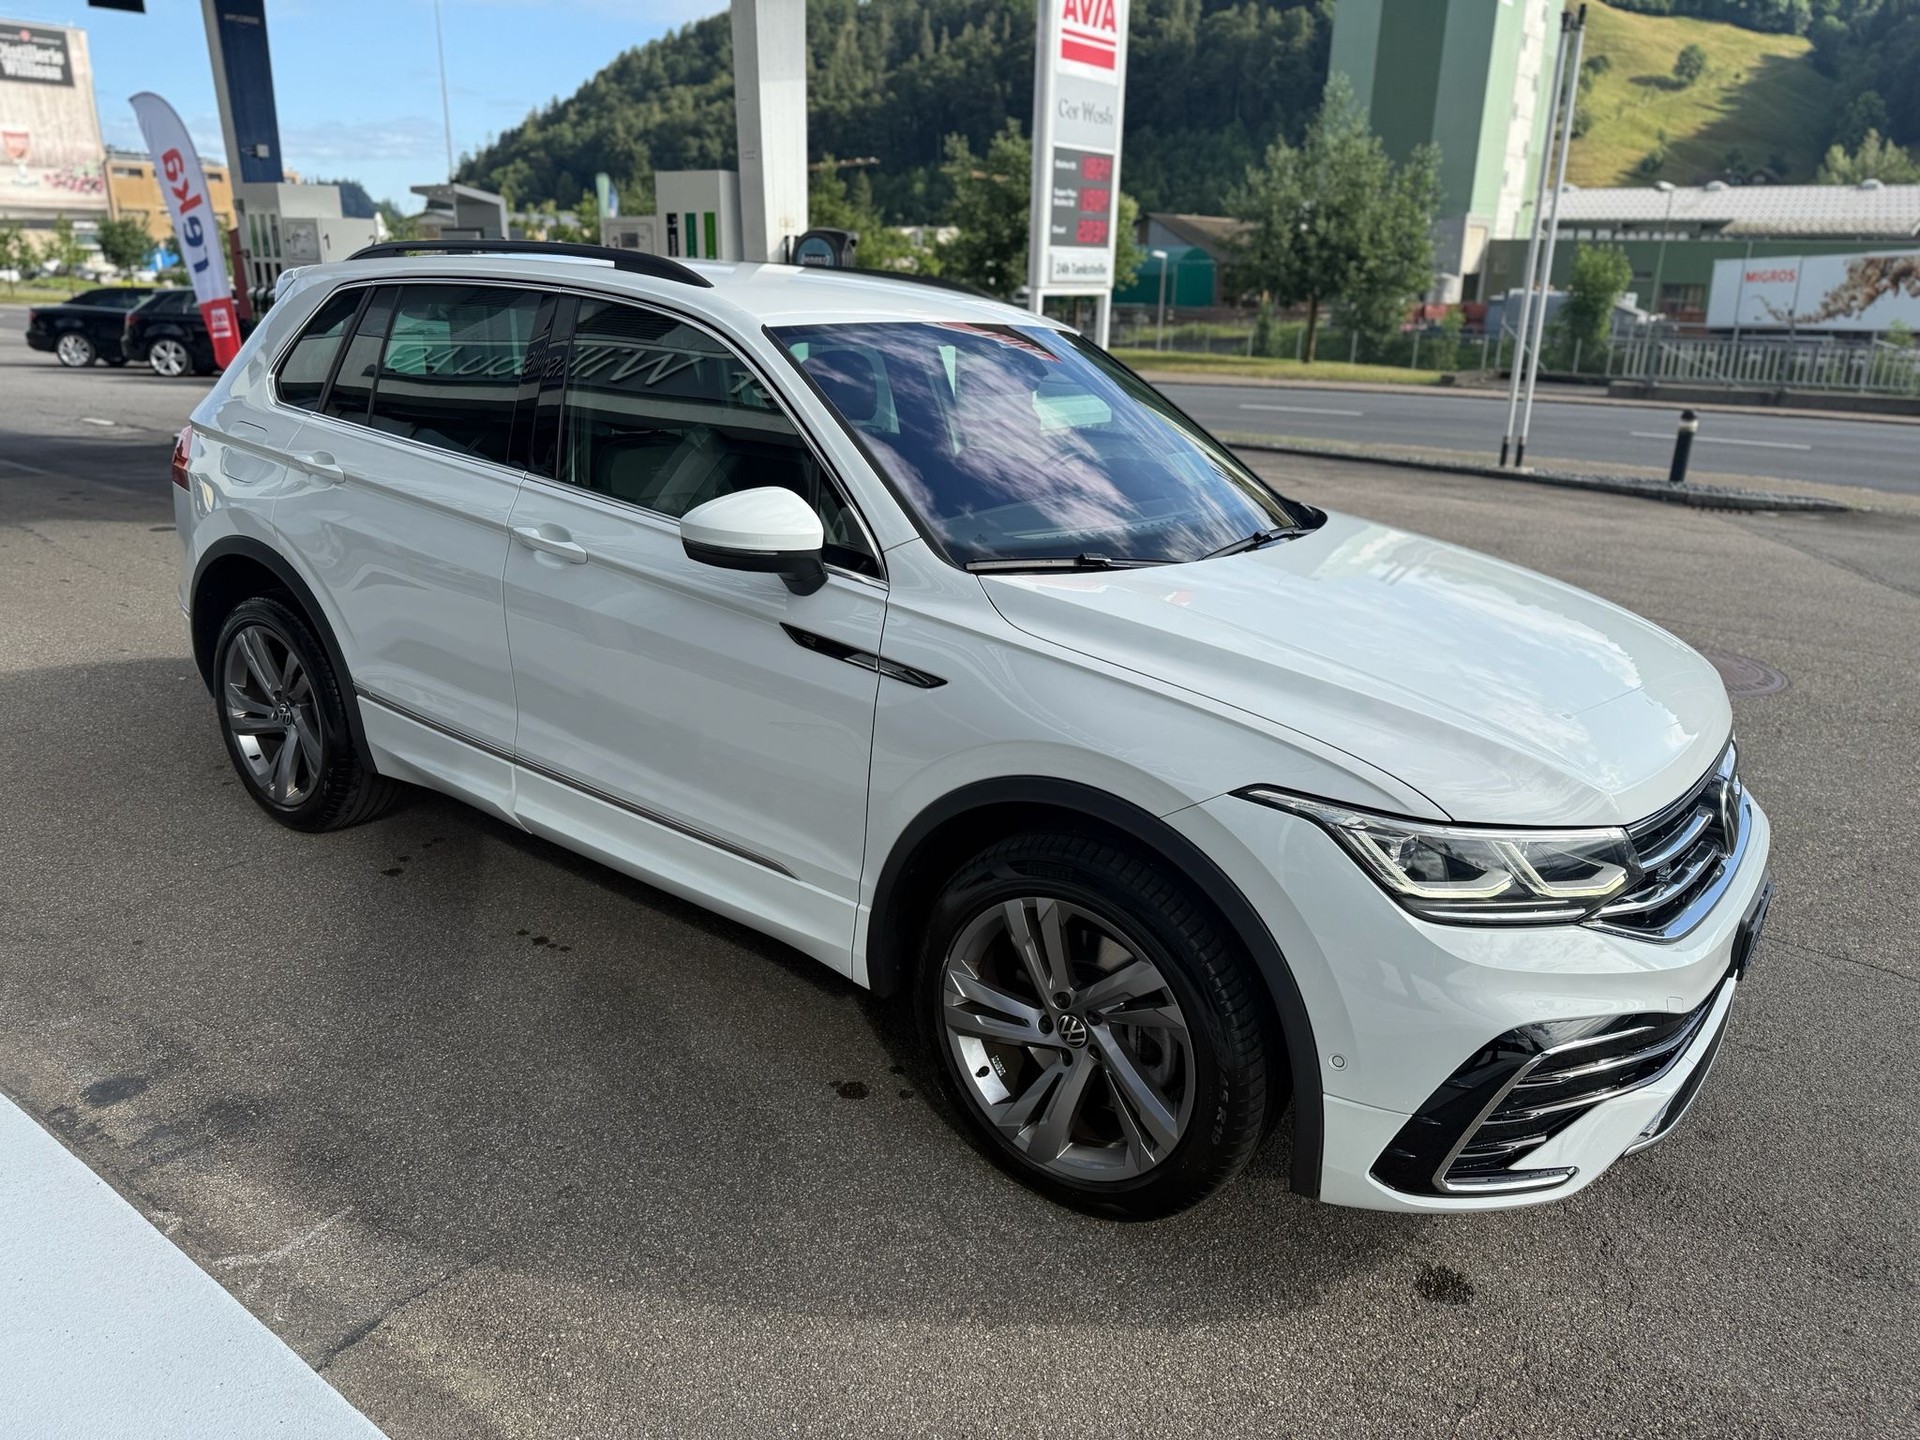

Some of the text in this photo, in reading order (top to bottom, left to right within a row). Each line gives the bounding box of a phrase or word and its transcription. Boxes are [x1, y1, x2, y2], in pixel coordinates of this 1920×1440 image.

[1063, 0, 1116, 33] AVIA
[161, 150, 210, 275] reka
[1745, 269, 1796, 283] MIGROS
